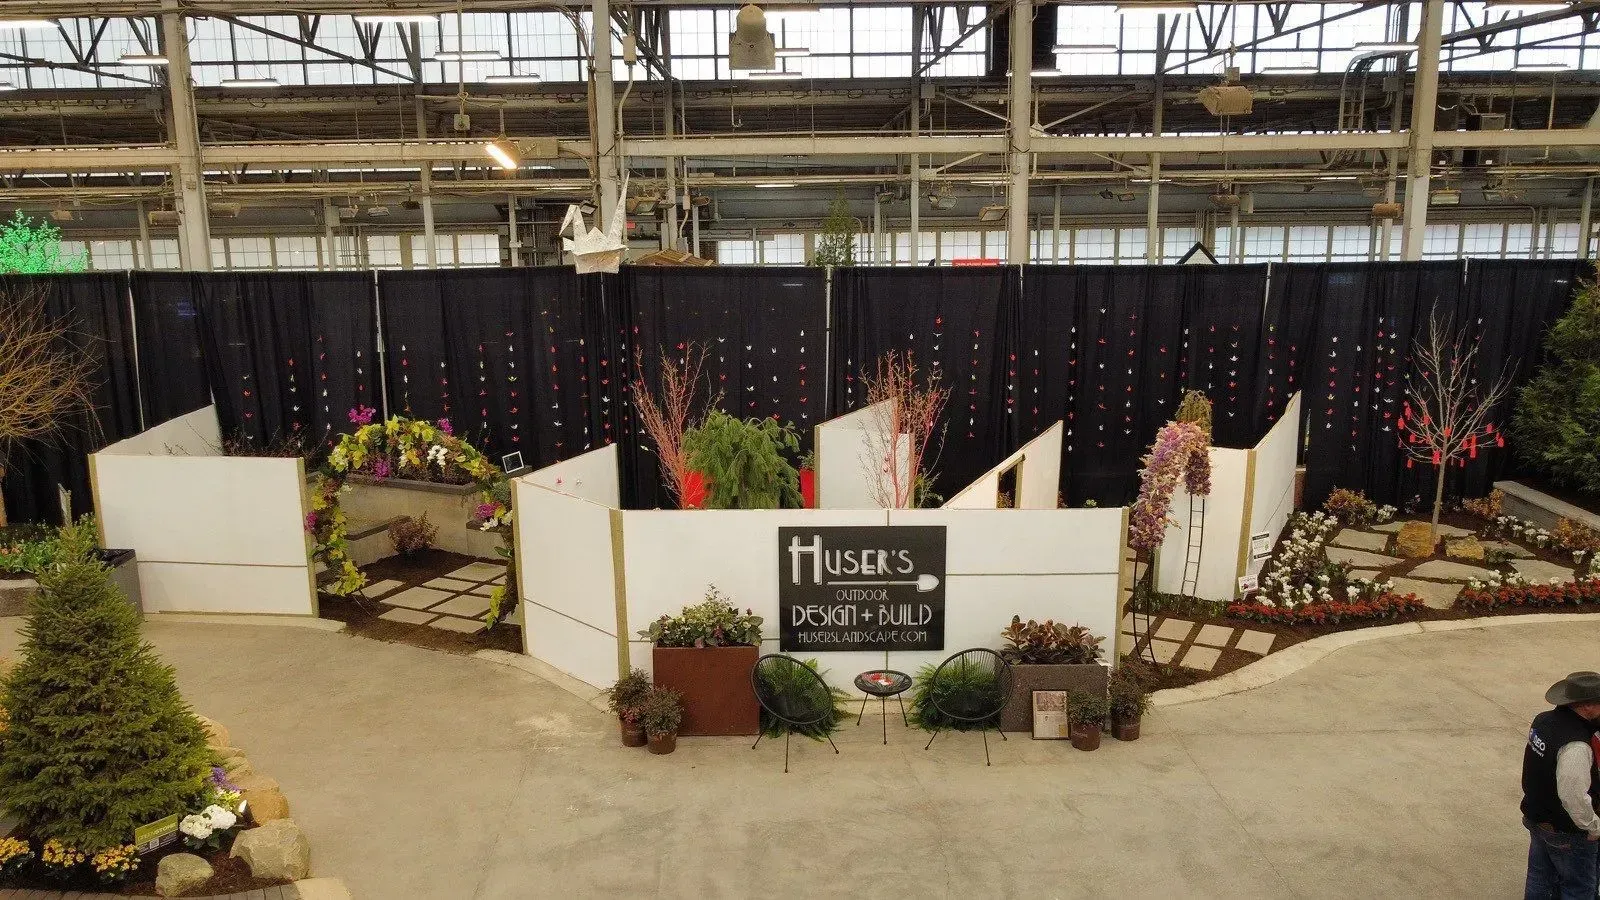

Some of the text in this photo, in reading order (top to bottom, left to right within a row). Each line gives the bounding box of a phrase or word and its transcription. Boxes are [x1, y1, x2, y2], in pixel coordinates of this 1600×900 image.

[788, 534, 915, 585] HUSER'S
[836, 589, 889, 601] OUTDOOR
[792, 604, 933, 627] DESIGN + BUILD
[798, 630, 927, 643] HUSERSLANDSCAPE.COM
